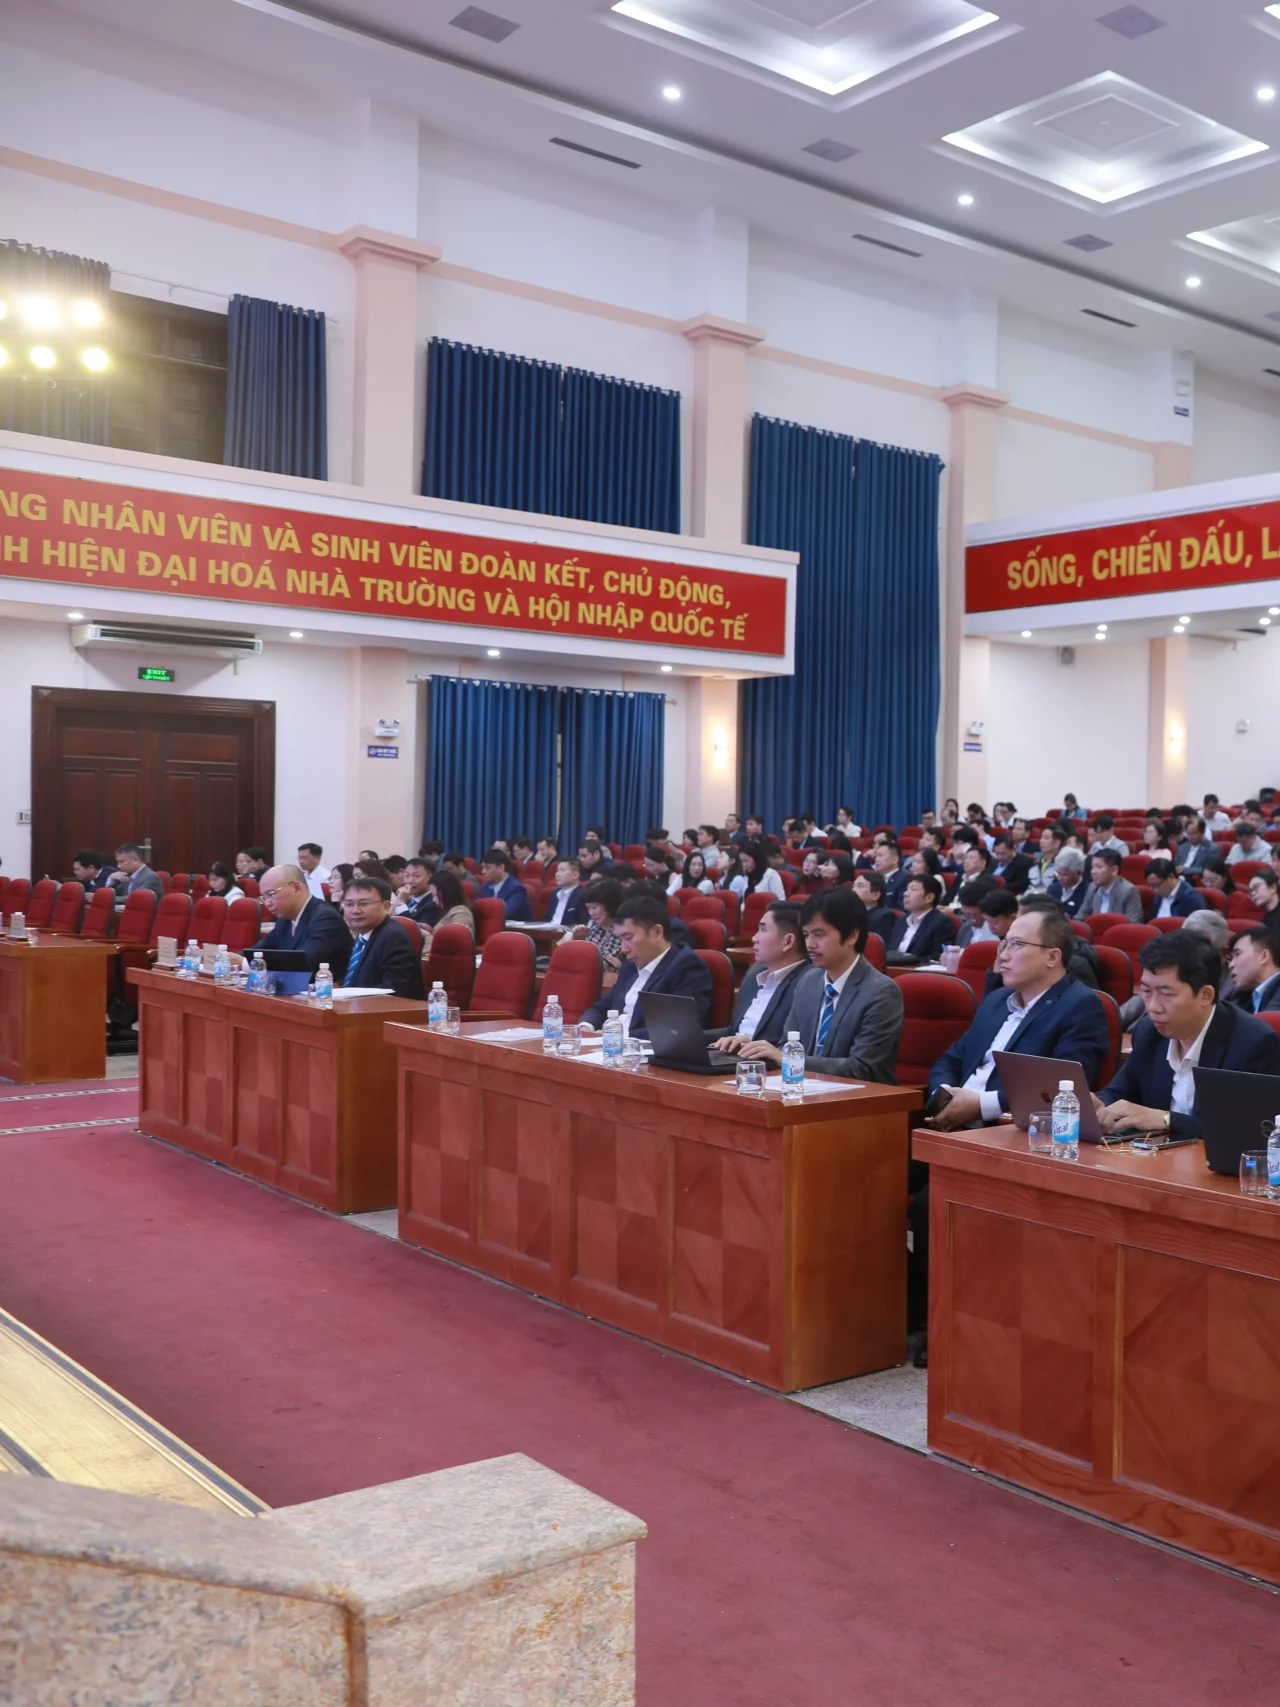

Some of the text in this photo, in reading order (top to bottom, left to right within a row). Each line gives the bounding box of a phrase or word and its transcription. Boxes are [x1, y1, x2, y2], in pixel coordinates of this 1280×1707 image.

[42, 538, 125, 576] HIỆN
[137, 550, 197, 585] ĐẠI
[208, 559, 276, 590] HOÁ
[287, 568, 350, 598] NHÀ
[360, 577, 475, 611] TRƯỜNG
[484, 588, 520, 616] VÀ
[529, 593, 569, 625] HỘI
[578, 602, 643, 632] NHẬP
[651, 608, 714, 637] QUỐC
[720, 613, 749, 641] TẾ
[62, 499, 166, 536] NHÂN
[177, 513, 252, 548] VIÊN
[262, 522, 301, 553] VÀ
[312, 532, 380, 563] SINH
[389, 541, 452, 572] VIÊN
[460, 552, 535, 582] ĐOÀN
[545, 558, 594, 592] KẾT,
[604, 568, 652, 596] CHỦ
[659, 576, 730, 608] ĐỘNG,
[1008, 546, 1082, 589] SỐNG,
[1093, 530, 1171, 579] CHIẾN
[1180, 520, 1252, 569] ĐẤU,
[146, 668, 167, 676] EXIT
